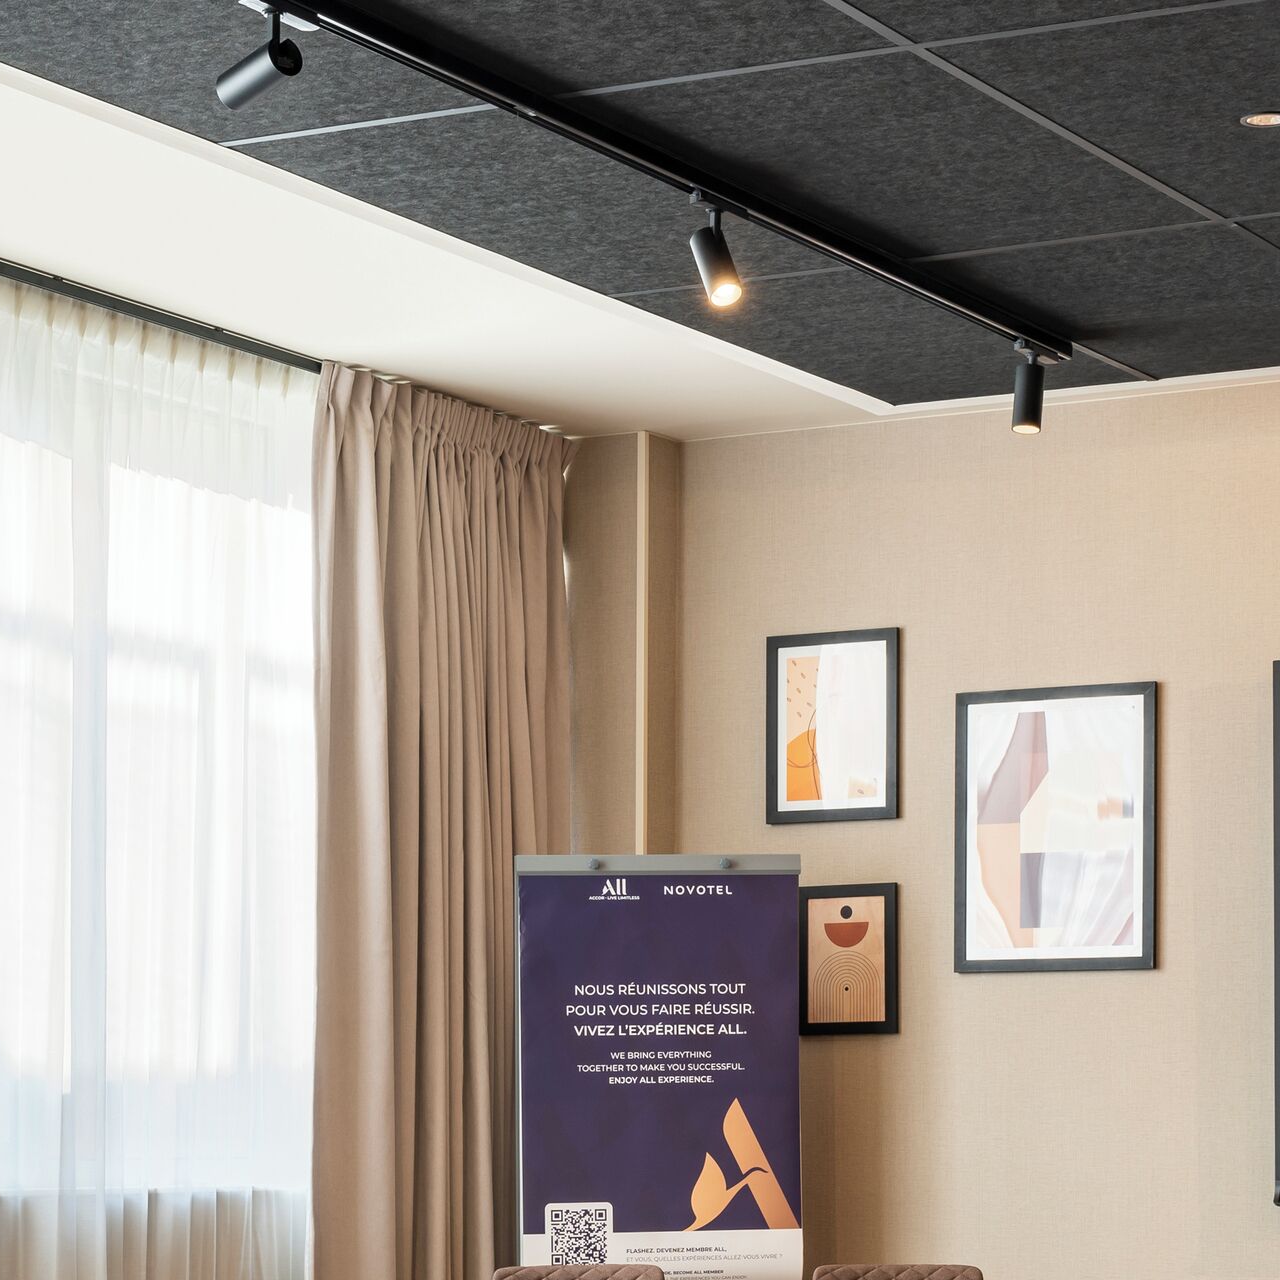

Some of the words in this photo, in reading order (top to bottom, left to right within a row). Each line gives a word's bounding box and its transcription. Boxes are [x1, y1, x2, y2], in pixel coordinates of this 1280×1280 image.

[663, 885, 733, 896] NOVOTEL
[573, 984, 615, 996] NOUS
[618, 981, 707, 996] RÉUNISSONS
[708, 982, 746, 995] TOUT
[566, 1004, 606, 1017] POUR
[609, 1004, 648, 1017] VOUS
[651, 1003, 691, 1016] FAIRE
[694, 1001, 756, 1016] RÉUSSIR.
[573, 1024, 615, 1037] VIVEZ
[718, 1023, 747, 1035] ALL.
[610, 1051, 626, 1060] WE
[627, 1051, 656, 1060] BRING
[657, 1050, 712, 1059] EVERYTHING
[577, 1064, 624, 1073] TOGETHER
[625, 1064, 638, 1073] TO
[639, 1063, 665, 1072] MAKE
[666, 1063, 686, 1072] YOU
[687, 1063, 745, 1072] SUCCESSFUL.
[608, 1076, 638, 1085] ENJOY
[639, 1076, 656, 1084] ALL
[657, 1075, 715, 1084] EXPERIENCE.
